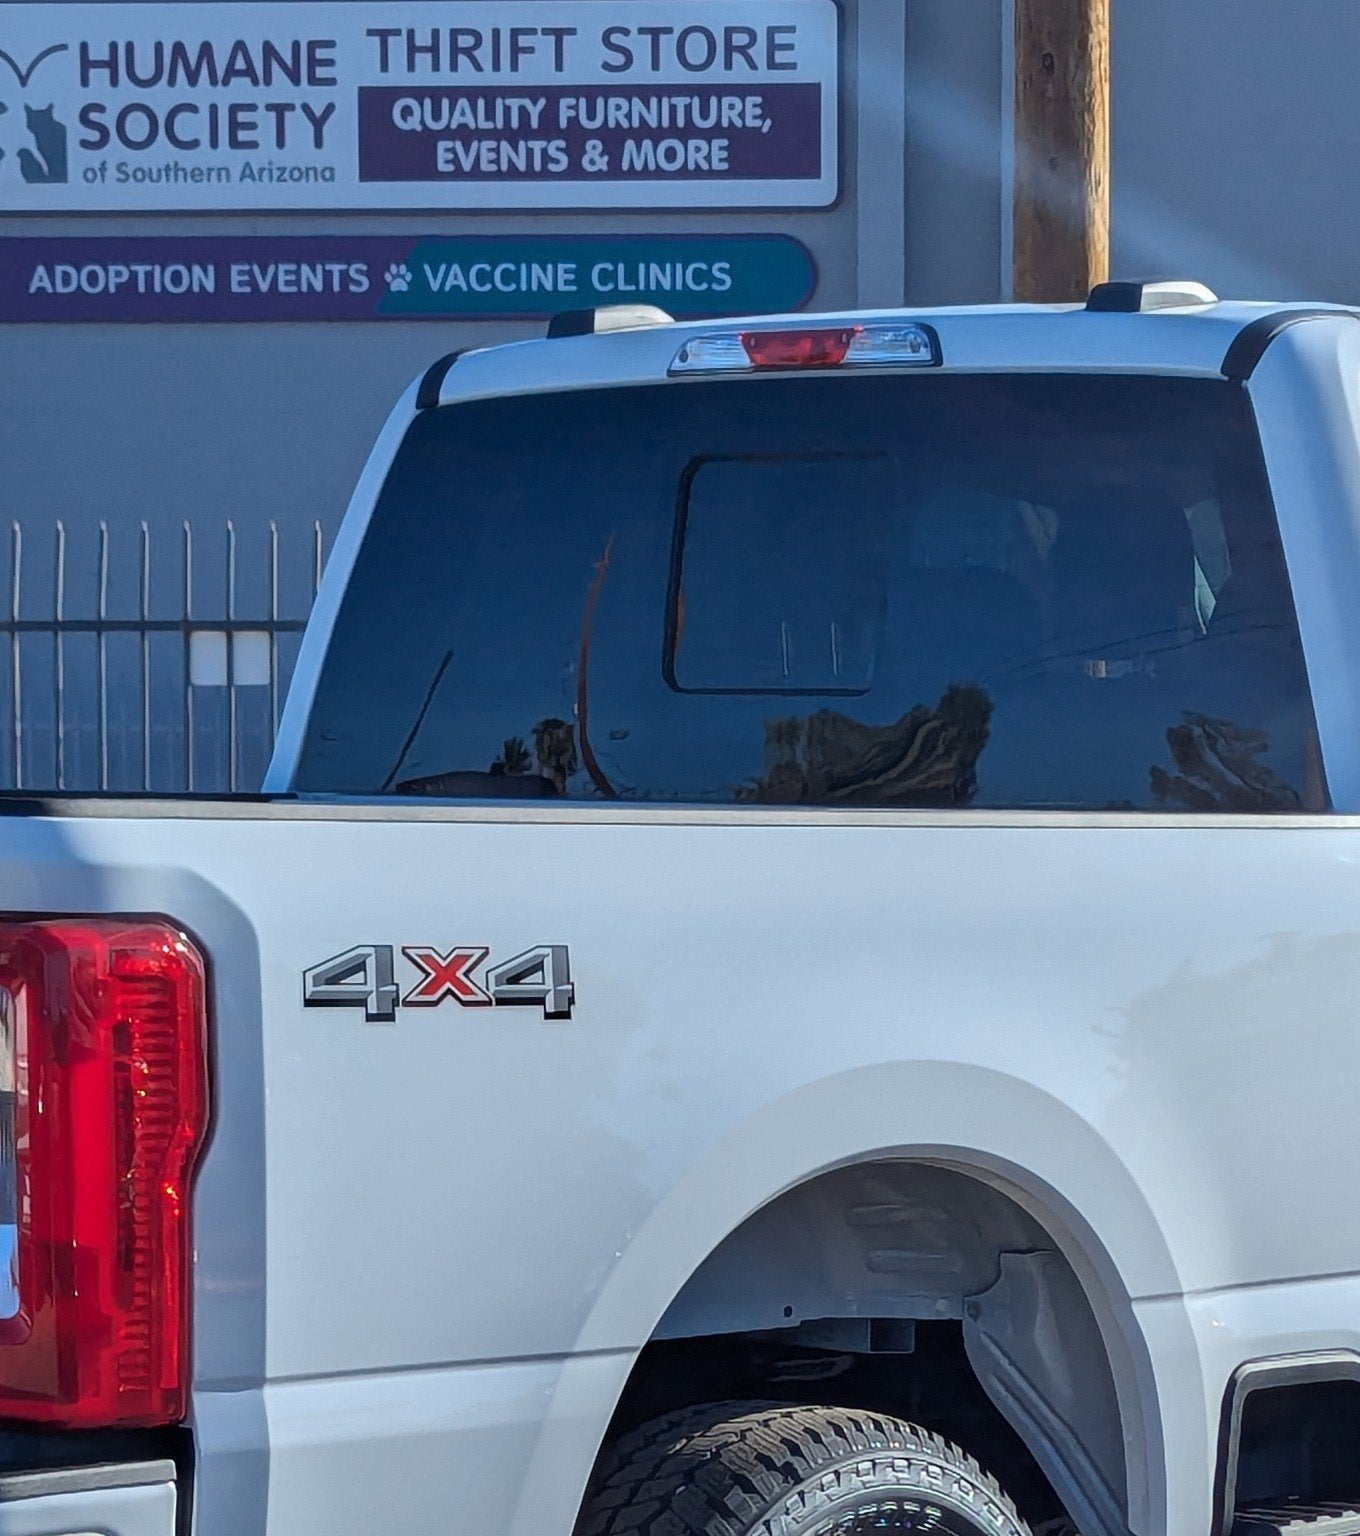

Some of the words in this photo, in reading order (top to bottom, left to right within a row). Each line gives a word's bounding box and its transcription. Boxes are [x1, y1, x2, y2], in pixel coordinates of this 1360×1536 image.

[79, 39, 338, 89] HUMANE
[365, 27, 578, 74] THRIFT
[600, 25, 798, 73] STORE
[78, 101, 337, 151] SOCIETY
[392, 96, 547, 132] QUALITY
[559, 95, 772, 135] FURNITURE,
[82, 160, 108, 184] of
[115, 160, 232, 184] Southern
[238, 160, 336, 184] Arizona
[436, 139, 569, 173] EVENTS
[581, 139, 609, 173] &
[621, 138, 730, 172] MORE
[28, 264, 215, 294] ADOPTION
[230, 262, 370, 293] EVENTS
[423, 262, 578, 292] VACCINE
[591, 262, 732, 292] CLINICS
